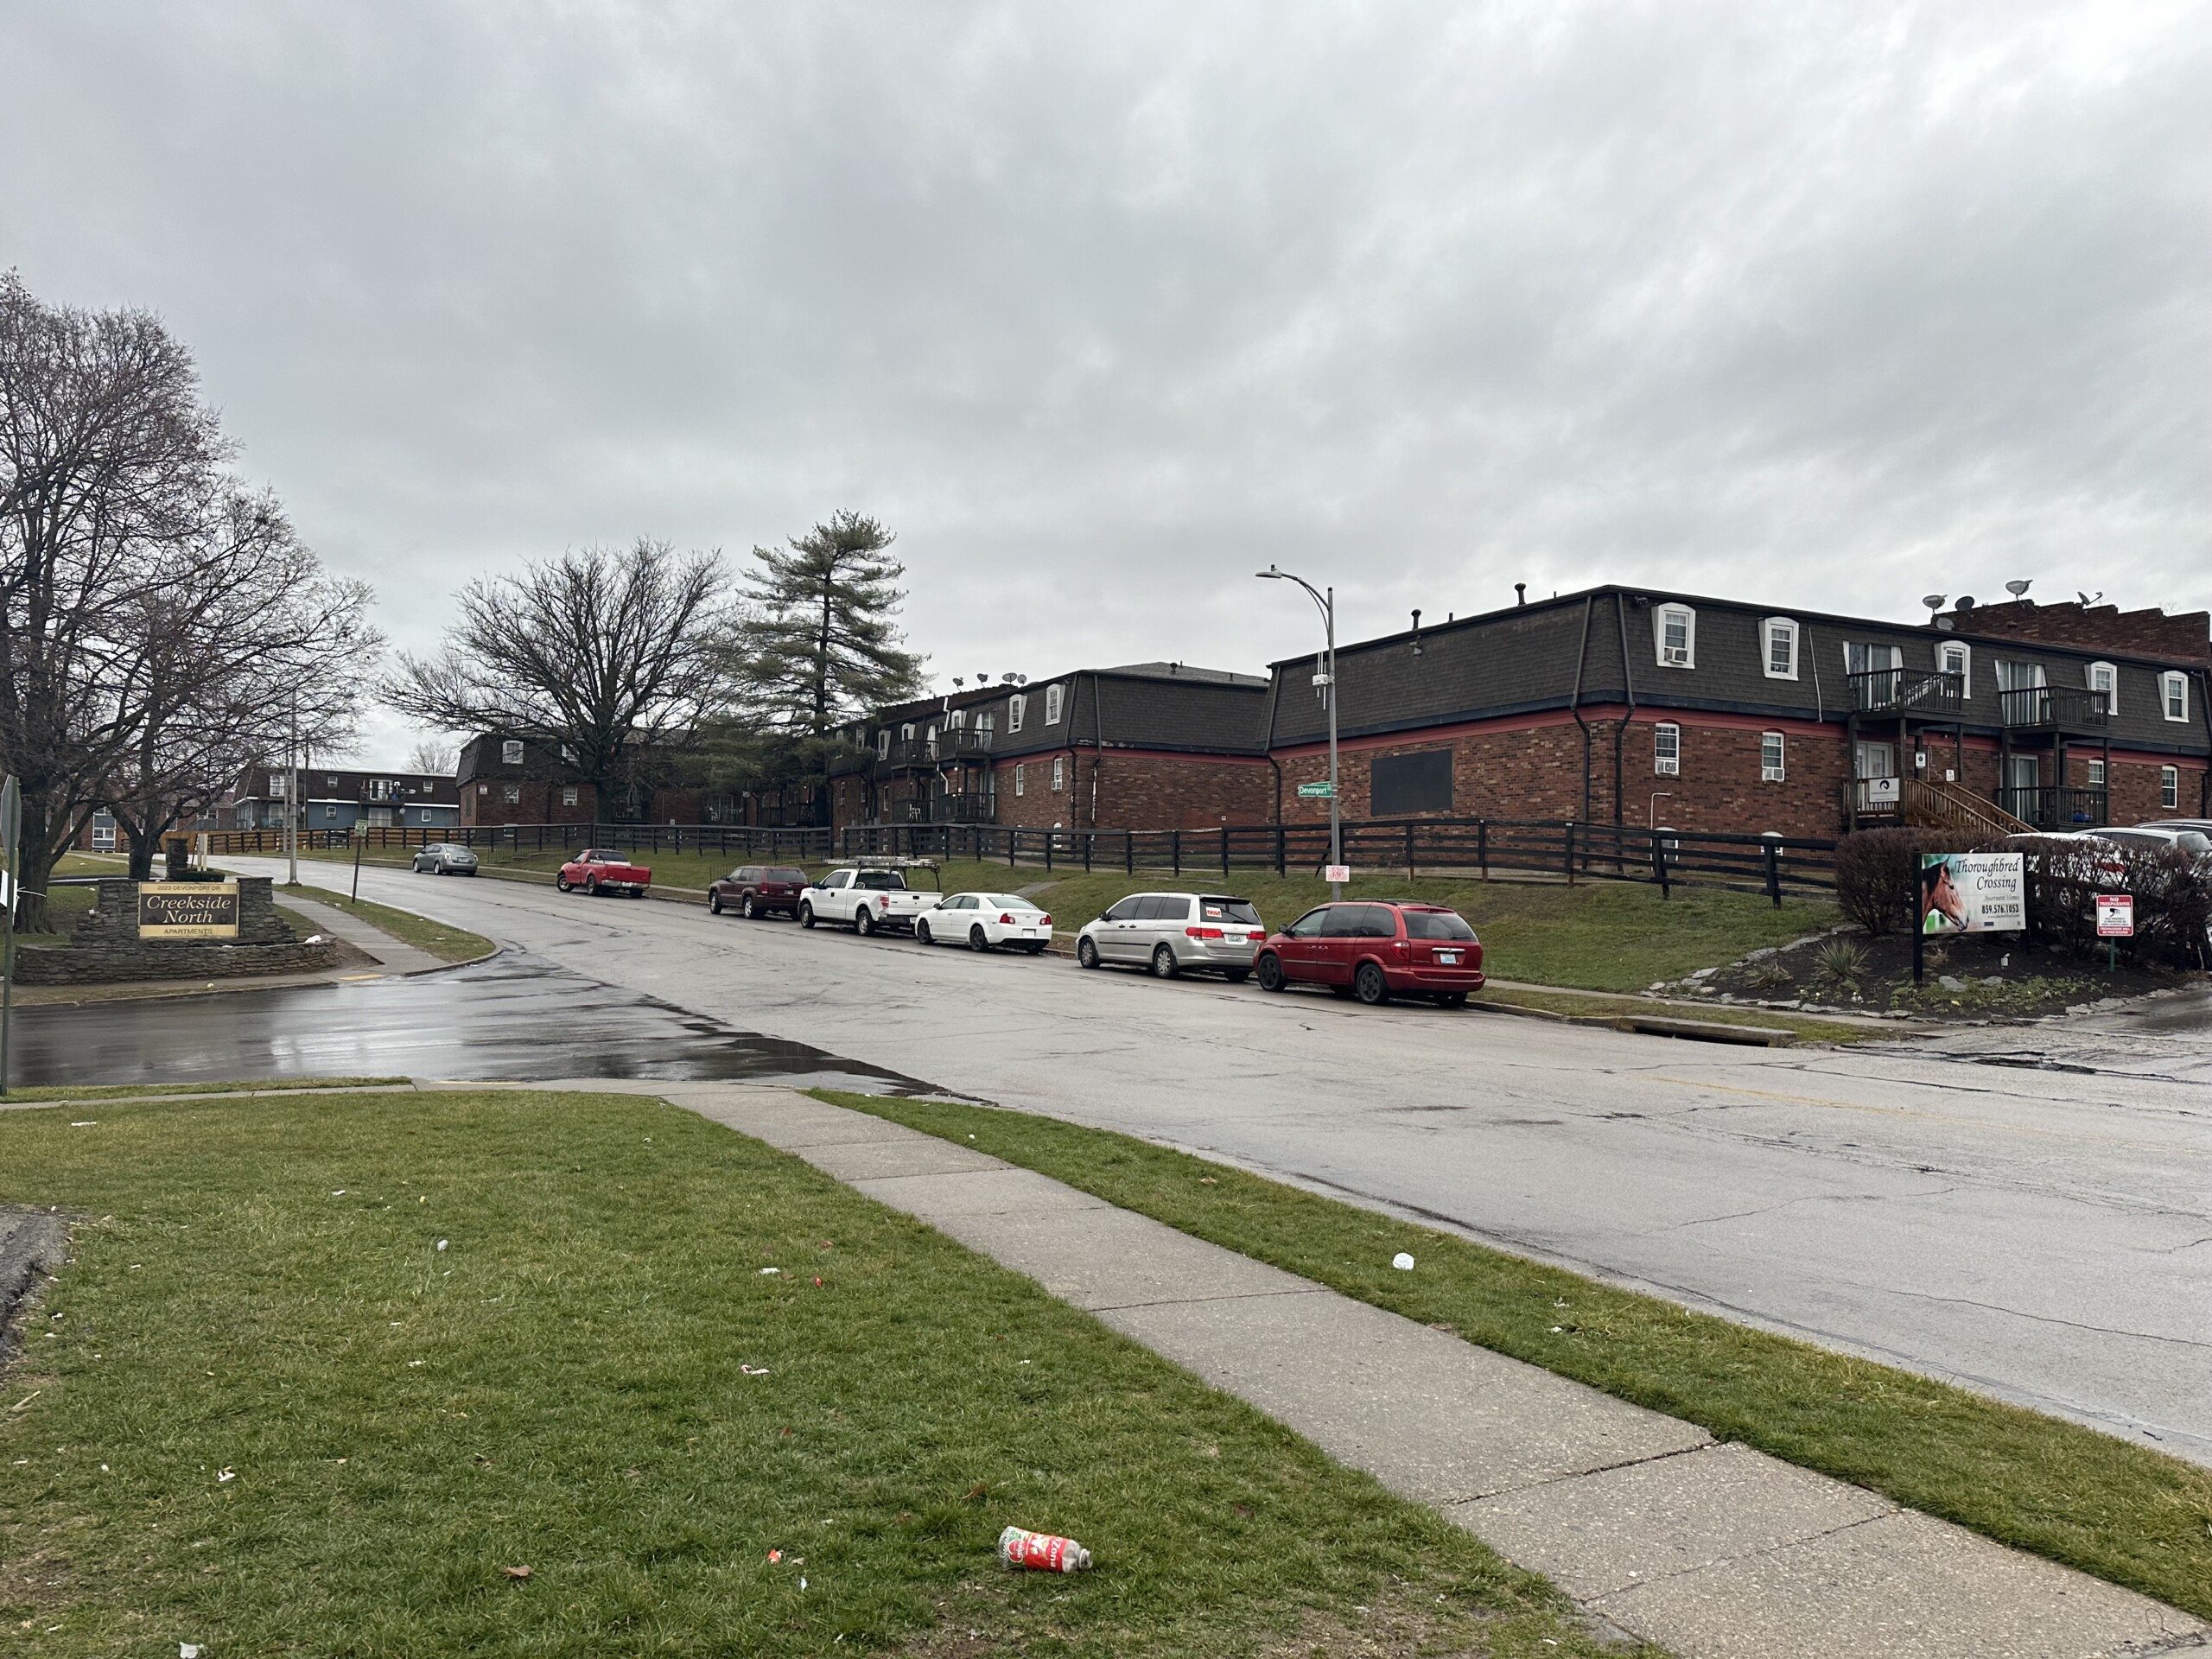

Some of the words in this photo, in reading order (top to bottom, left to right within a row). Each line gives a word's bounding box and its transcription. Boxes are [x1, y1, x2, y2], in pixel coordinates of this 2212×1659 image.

[1300, 786, 1327, 795] Devonport
[1955, 857, 2021, 877] Thoroughbred
[1977, 875, 2017, 892] Crossing
[147, 895, 231, 909] Creekside
[1981, 904, 2019, 914] 859.576.1053
[162, 910, 213, 924] North
